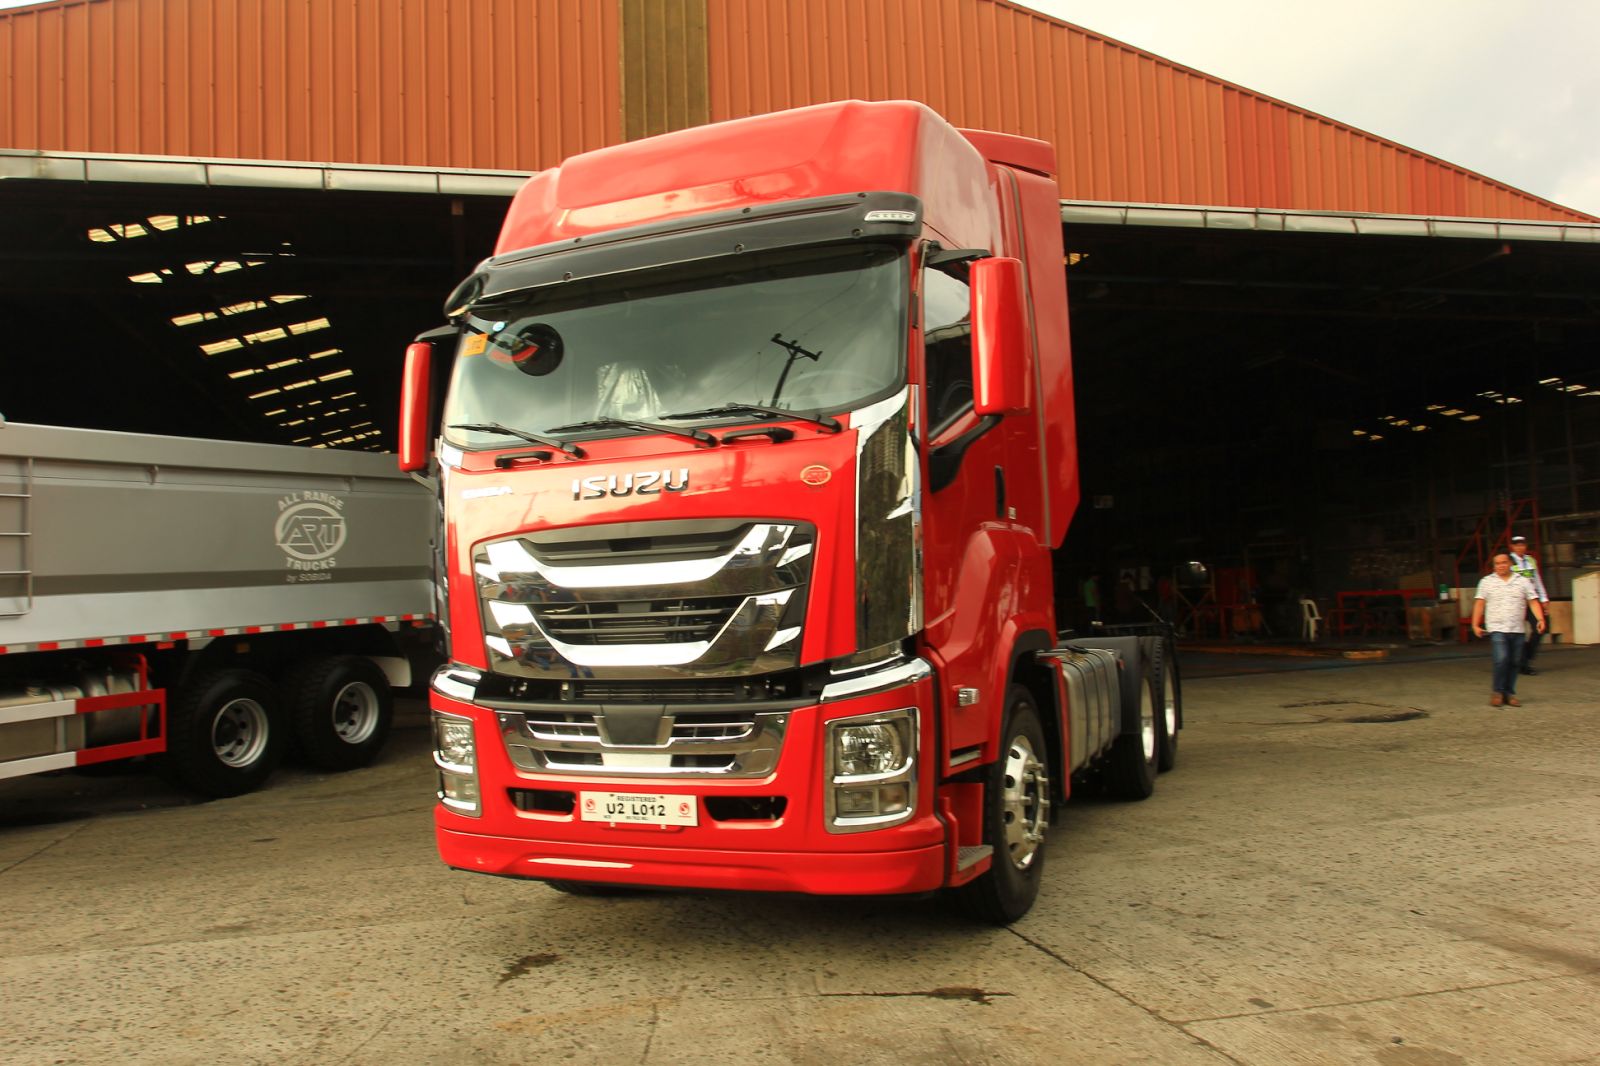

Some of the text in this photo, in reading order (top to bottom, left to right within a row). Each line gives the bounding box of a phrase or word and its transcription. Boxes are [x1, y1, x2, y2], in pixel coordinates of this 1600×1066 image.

[571, 468, 689, 501] ISUZU
[278, 490, 344, 511] ALL RANGE
[276, 515, 344, 554] ART
[286, 557, 336, 571] TRUCKS
[606, 802, 666, 817] U2 L012
